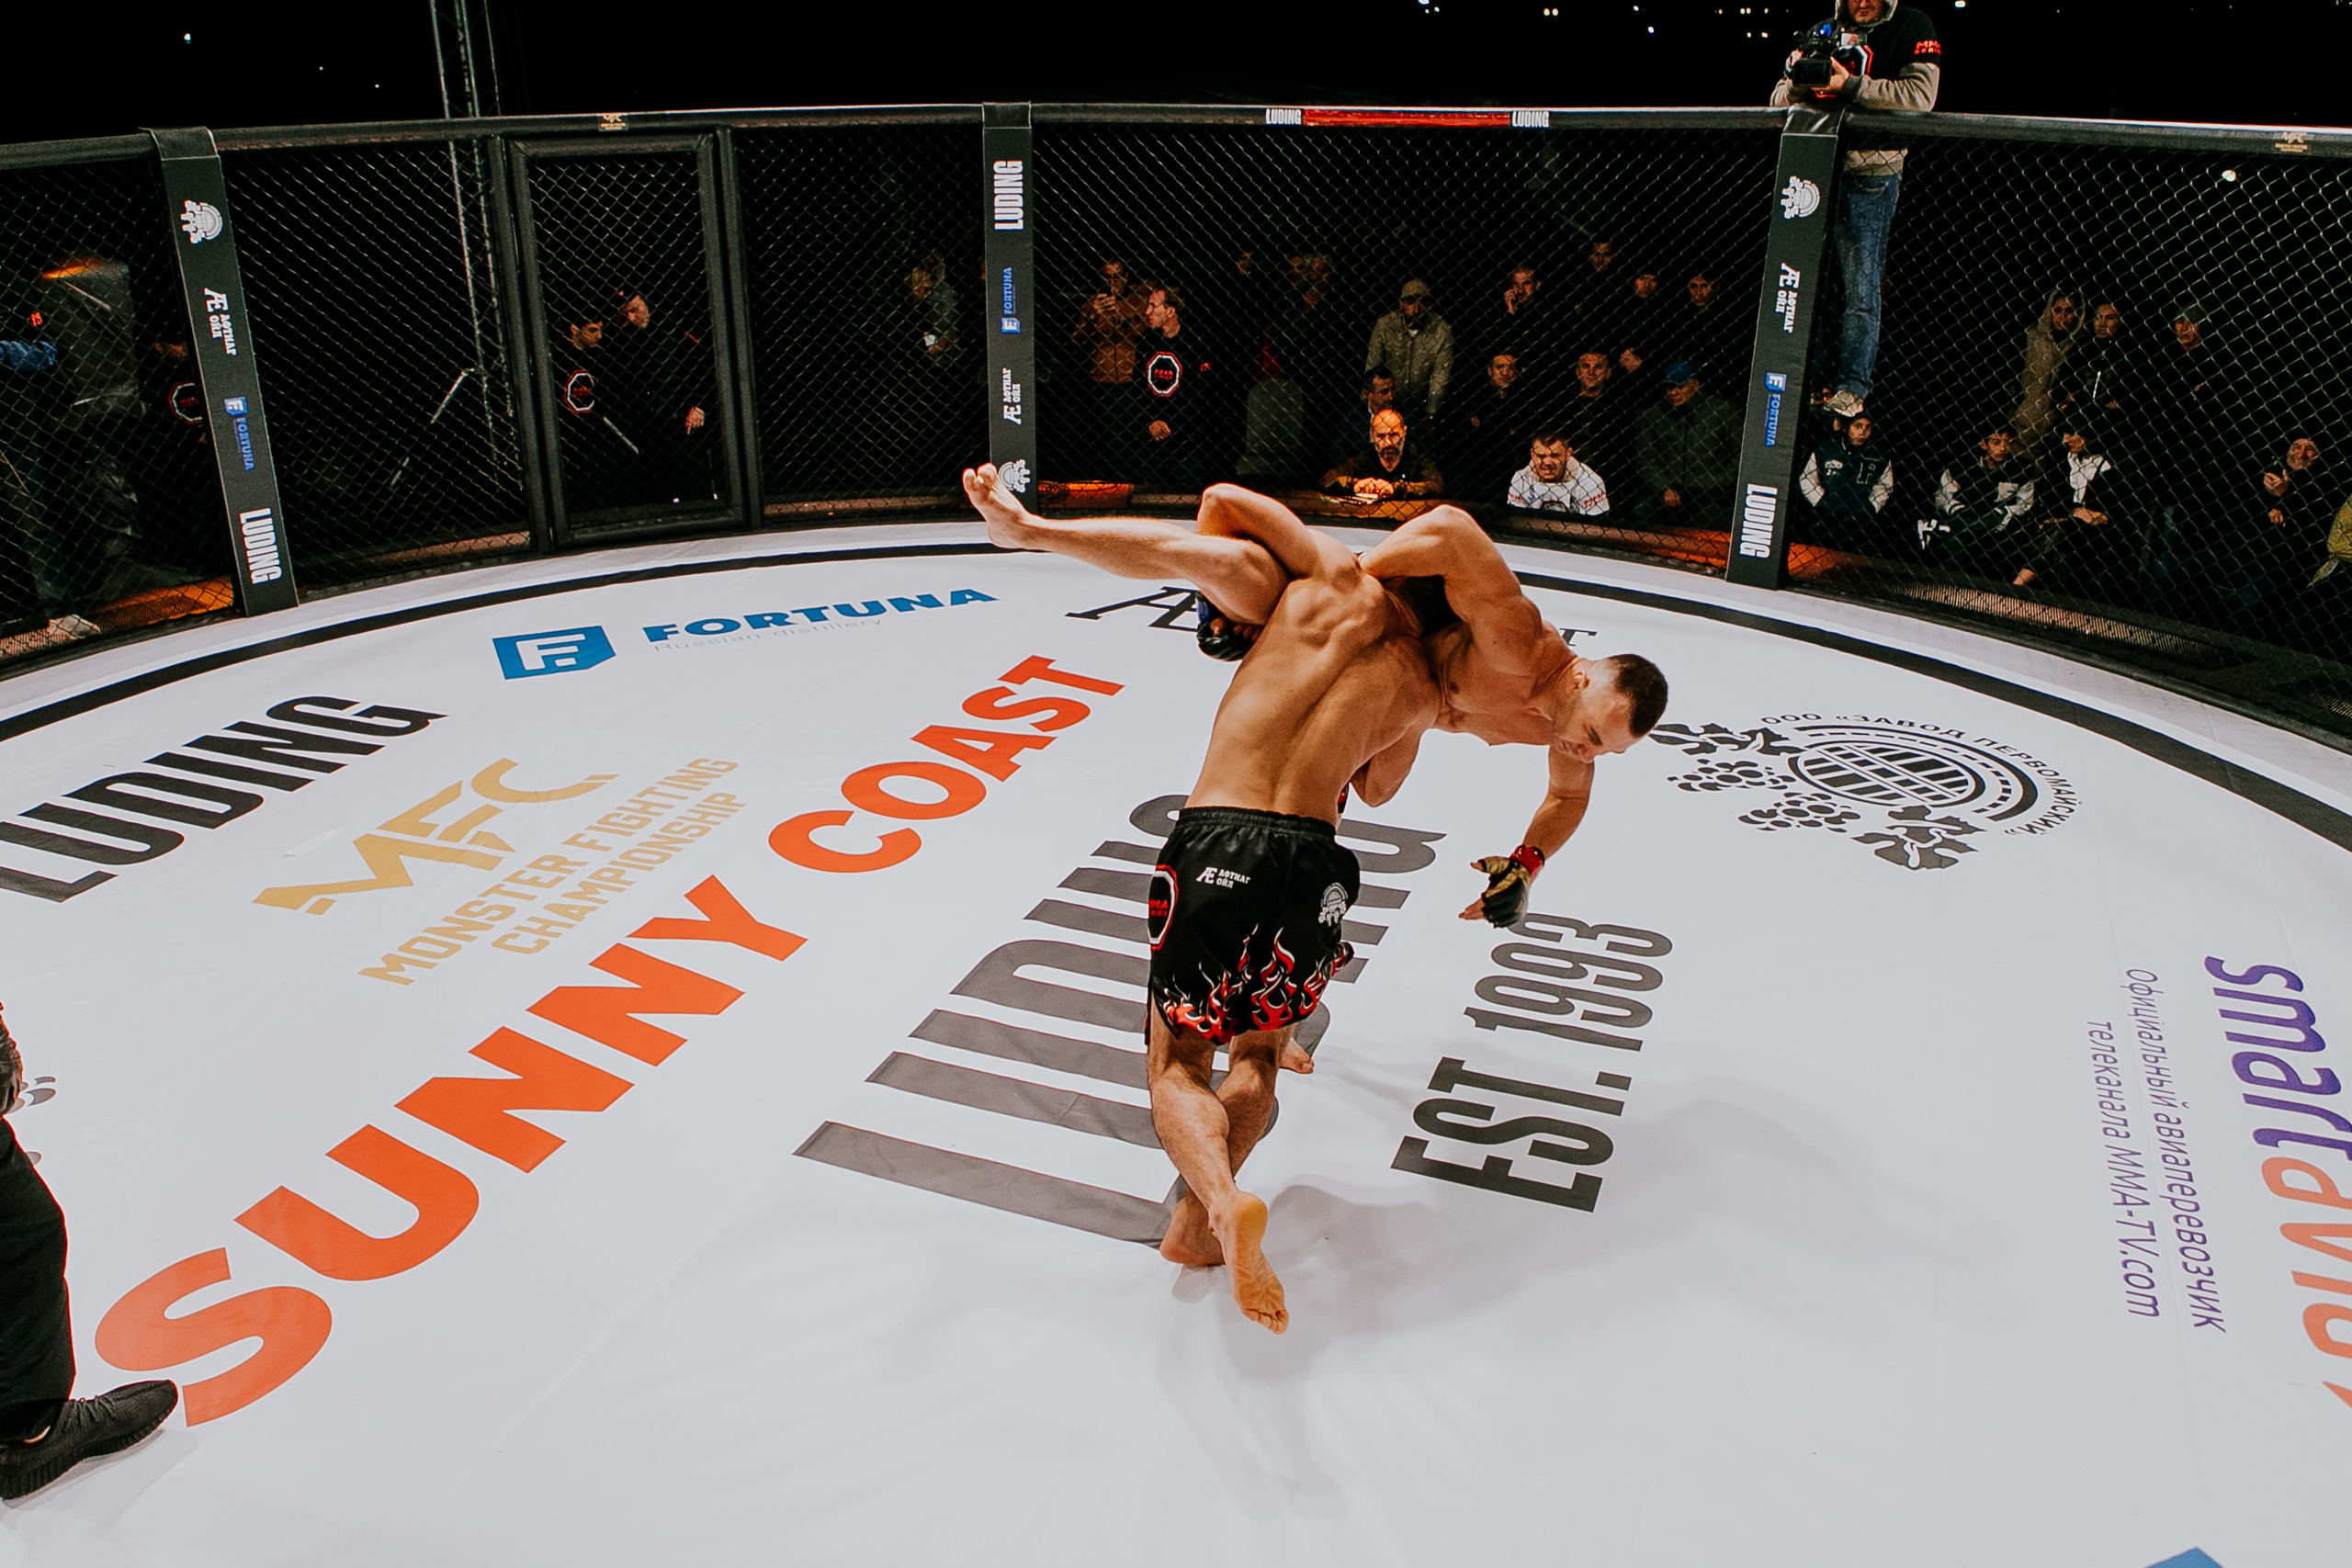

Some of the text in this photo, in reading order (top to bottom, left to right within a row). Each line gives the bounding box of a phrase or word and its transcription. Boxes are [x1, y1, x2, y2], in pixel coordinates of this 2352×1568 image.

[1265, 108, 1302, 124] LUDING
[1512, 111, 1549, 128] LUDING
[993, 160, 1023, 231] LUDING
[1003, 267, 1012, 315] FORTUNA
[237, 417, 254, 471] FORTUNA
[1765, 394, 1781, 447] FORTUNA
[239, 508, 282, 585] LUDING
[1740, 484, 1778, 558] LUDING
[643, 588, 1000, 642] FORTUNA
[653, 618, 882, 652] Russian distillery
[0, 695, 448, 903] LUDING
[253, 758, 619, 915] MFC
[357, 758, 739, 986] MONSTER FIGHTING
[492, 792, 746, 953] CHAMPIONSHIP
[95, 655, 1125, 1427] SUNNY COAST
[1390, 912, 1672, 1213] EST. 1993
[2086, 1020, 2161, 1318] телеканала MMA-TV.com
[2120, 968, 2226, 1334] Официальный авиаперевозчик
